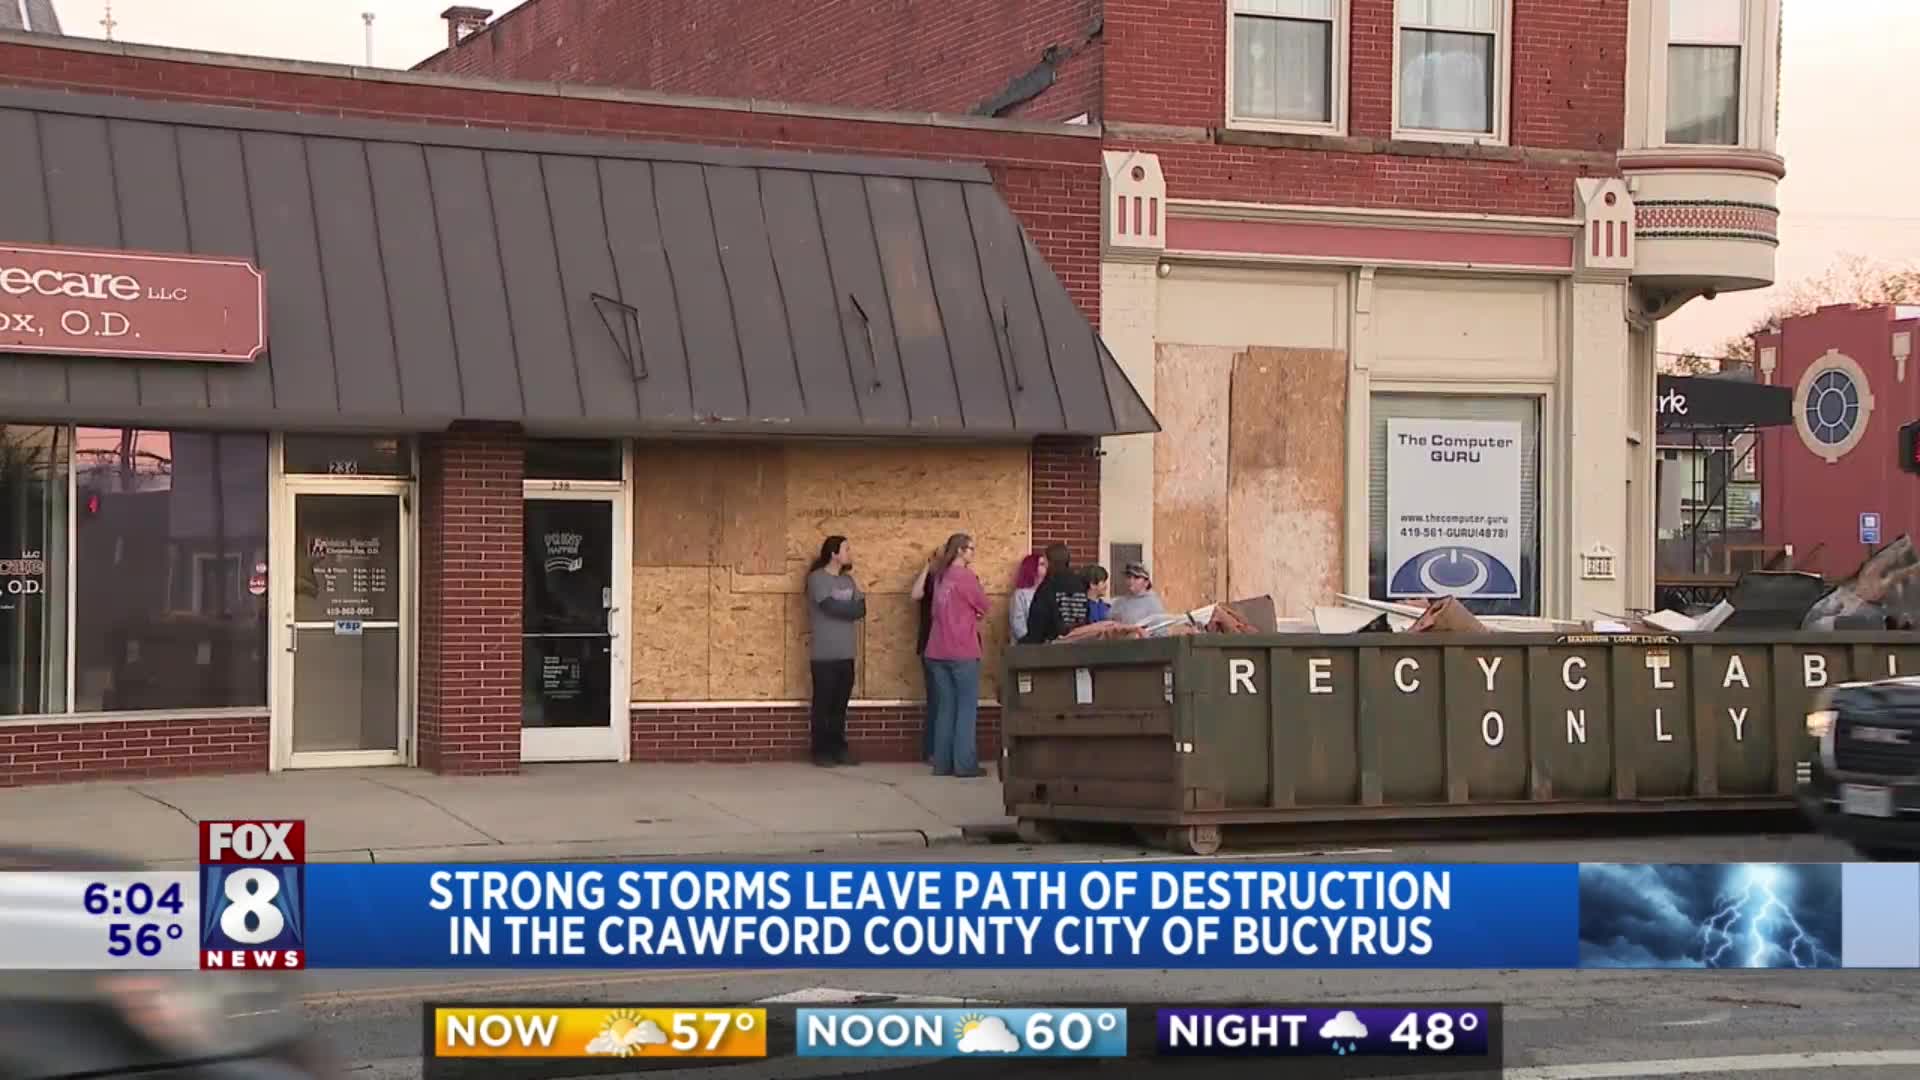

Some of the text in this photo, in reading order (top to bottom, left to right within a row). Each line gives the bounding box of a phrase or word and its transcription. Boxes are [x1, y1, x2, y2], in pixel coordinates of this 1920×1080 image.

[0, 267, 187, 300] ecare LLC
[61, 310, 141, 337] O.D.
[1655, 388, 1688, 415] rk
[1398, 433, 1513, 448] The Computer
[1431, 451, 1480, 462] GURU
[22, 550, 41, 559] LLC
[8, 580, 45, 594] O.D.
